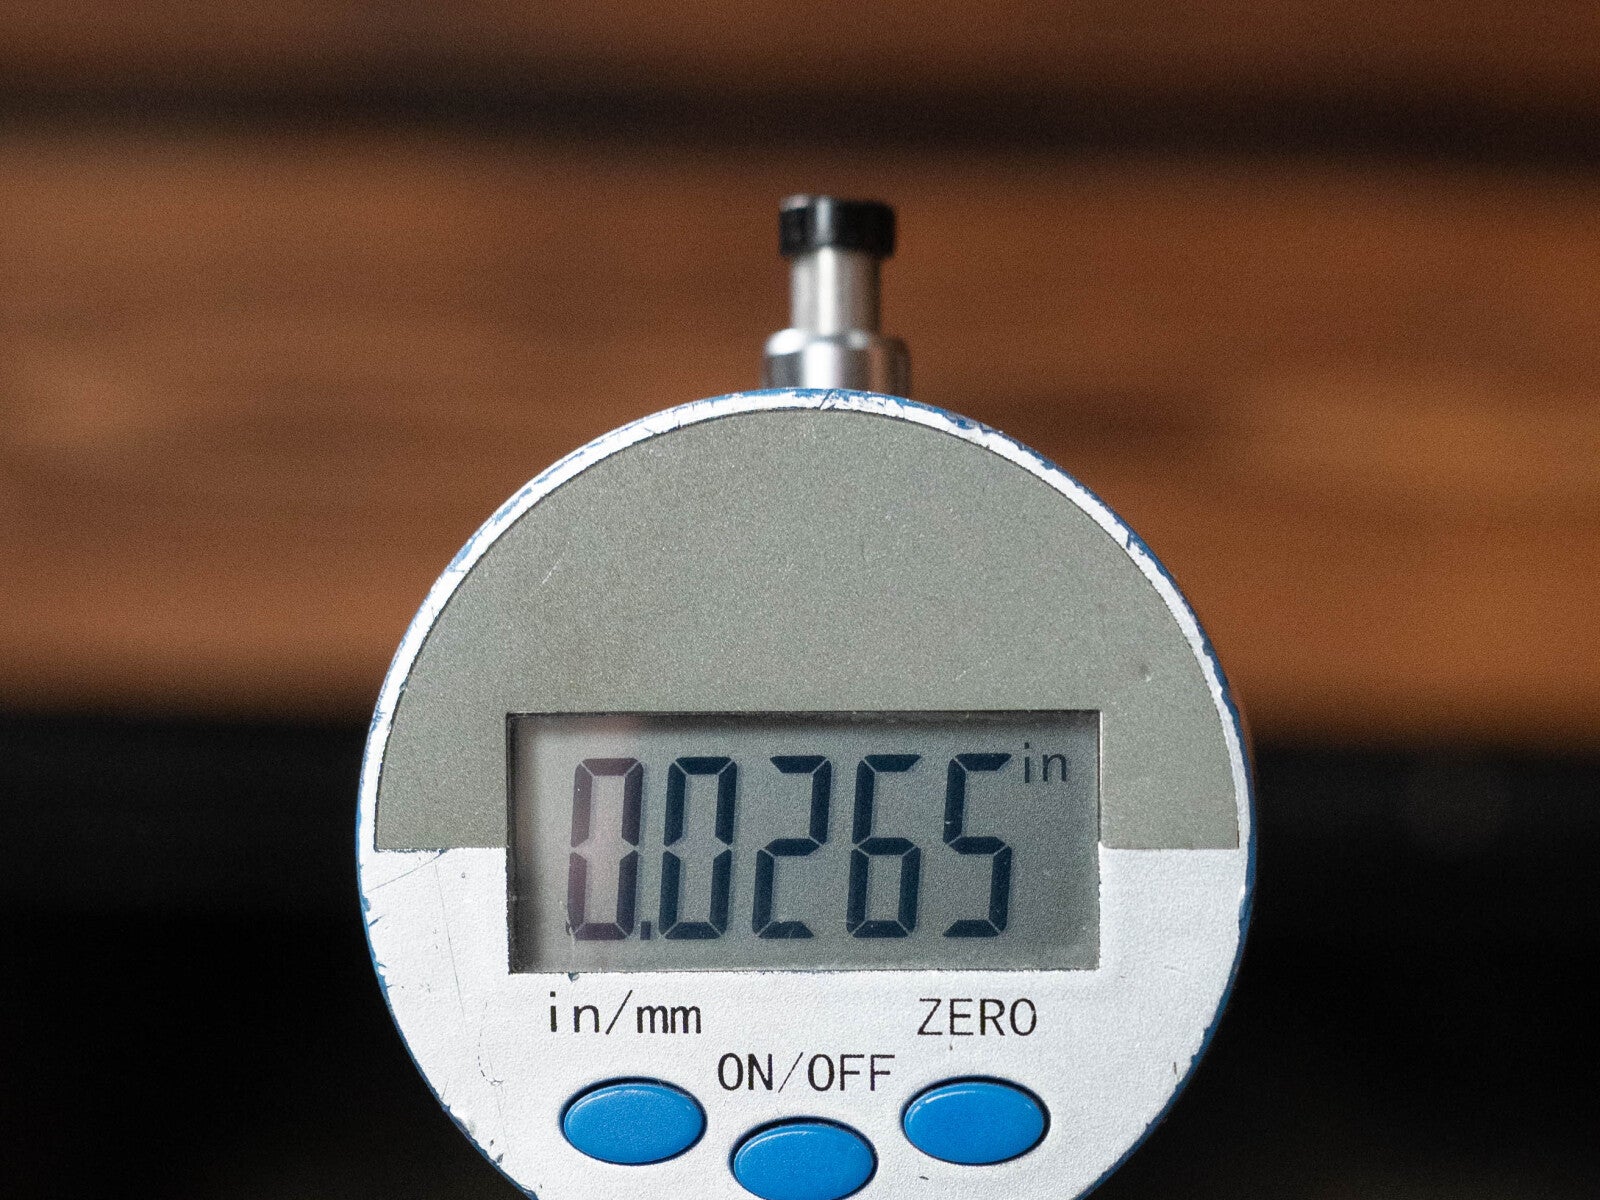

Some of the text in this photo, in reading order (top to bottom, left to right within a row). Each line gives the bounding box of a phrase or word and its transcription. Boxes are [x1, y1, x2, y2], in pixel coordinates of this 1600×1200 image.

[567, 742, 1069, 940] 0.0265 in
[549, 990, 702, 1035] in/mm
[916, 998, 1038, 1036] ZERO
[717, 1053, 896, 1093] ON/OFF
